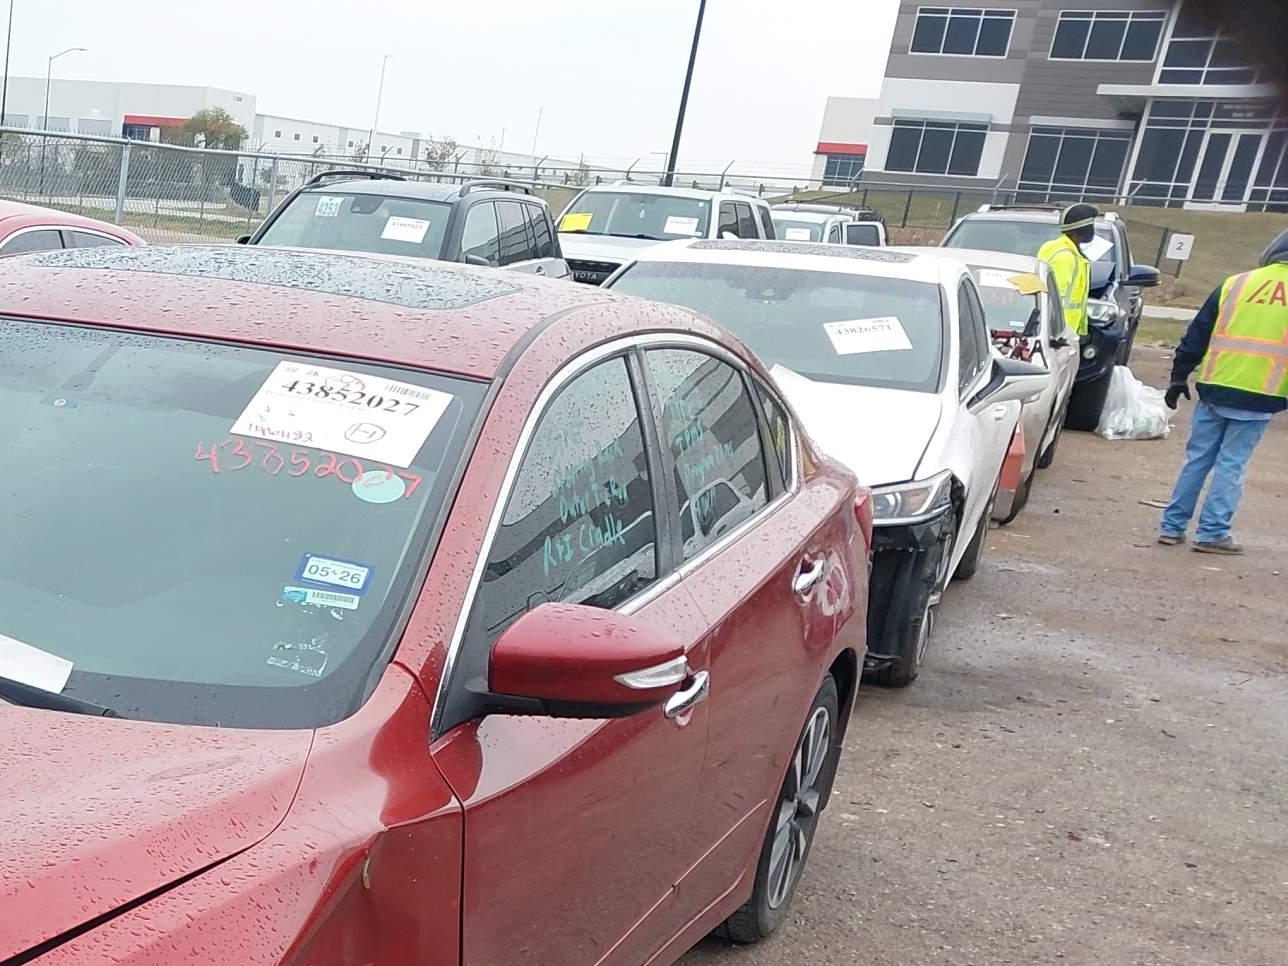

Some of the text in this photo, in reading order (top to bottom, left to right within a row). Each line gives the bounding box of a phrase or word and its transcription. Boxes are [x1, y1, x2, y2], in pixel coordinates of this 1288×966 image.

[1177, 241, 1184, 251] 2
[571, 270, 597, 280] YOTA
[281, 379, 421, 417] 43852027
